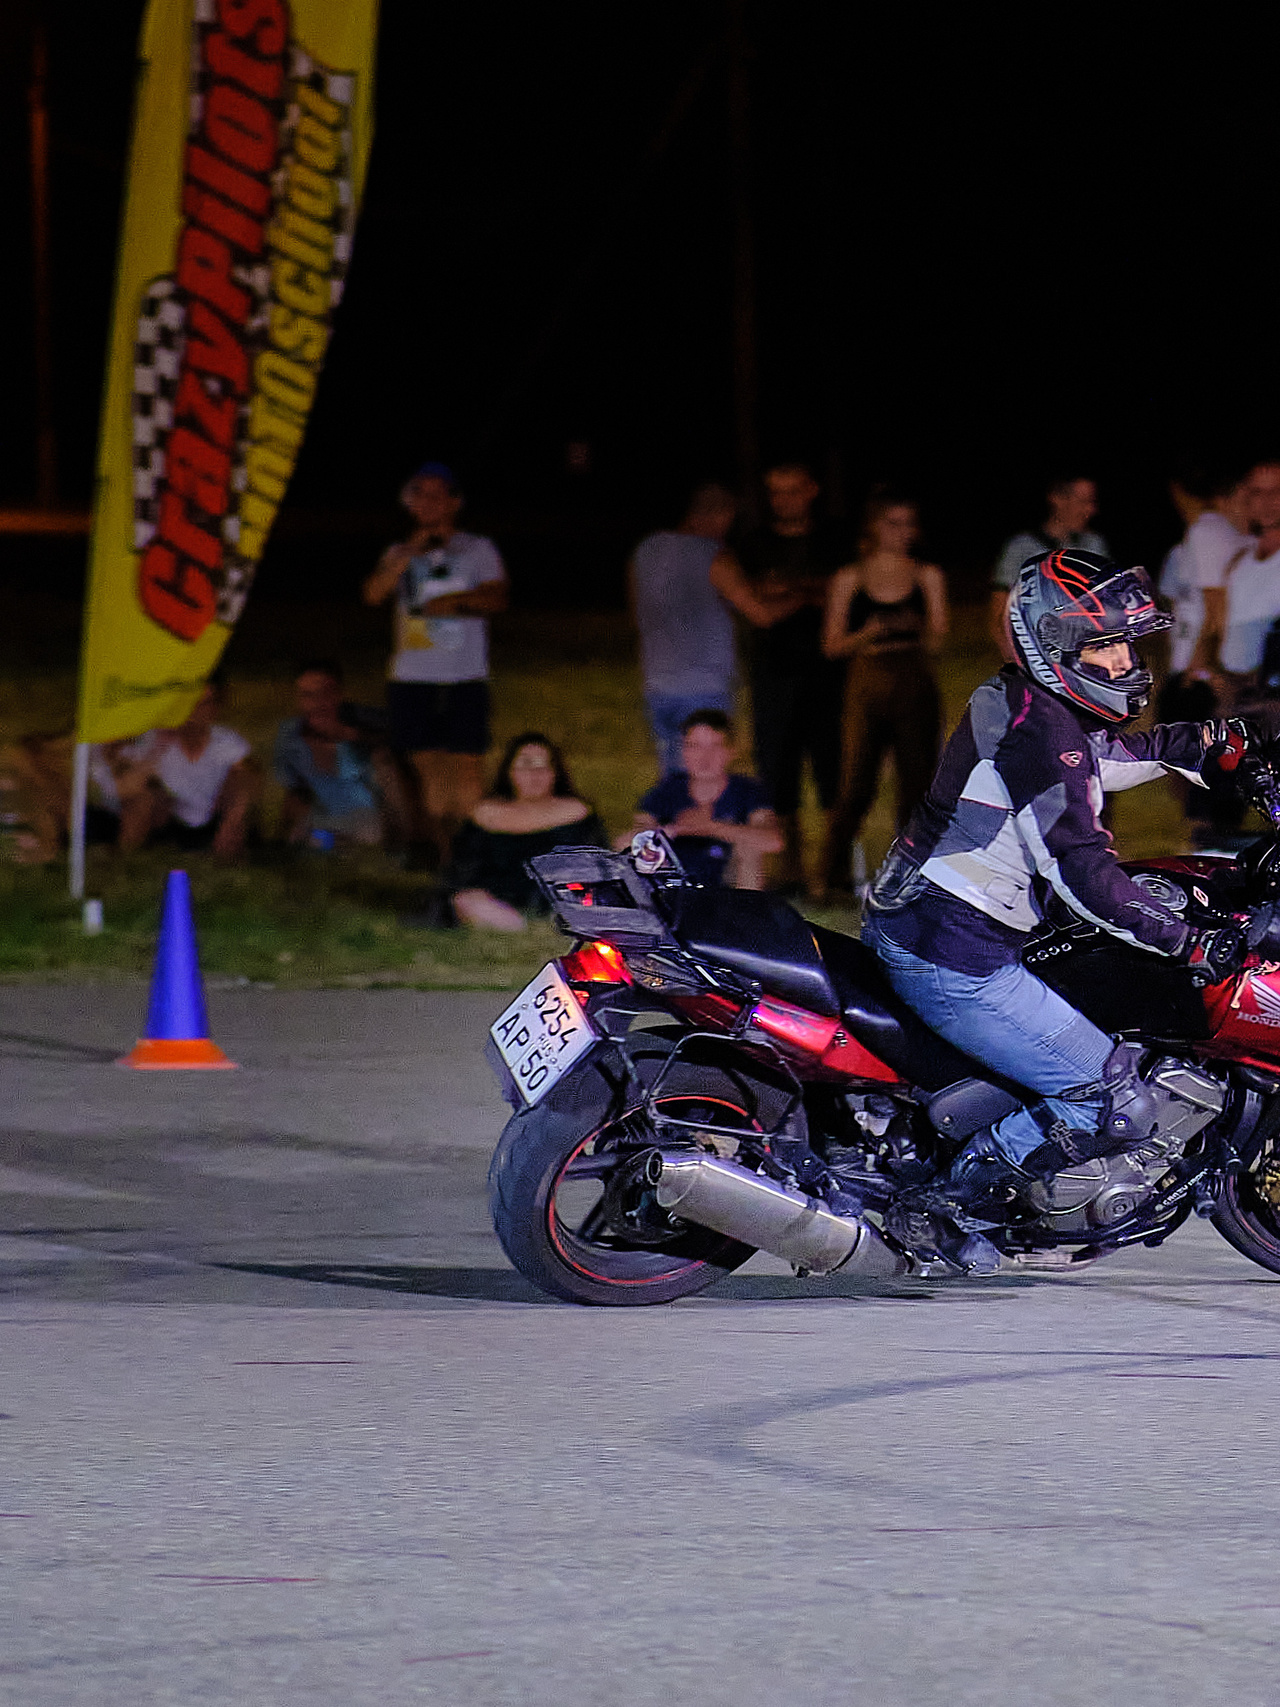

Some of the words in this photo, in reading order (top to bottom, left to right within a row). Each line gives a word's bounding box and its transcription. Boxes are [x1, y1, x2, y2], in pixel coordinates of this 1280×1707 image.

[497, 1012, 530, 1049] AP
[520, 1049, 549, 1091] 50
[533, 984, 577, 1052] 6254
